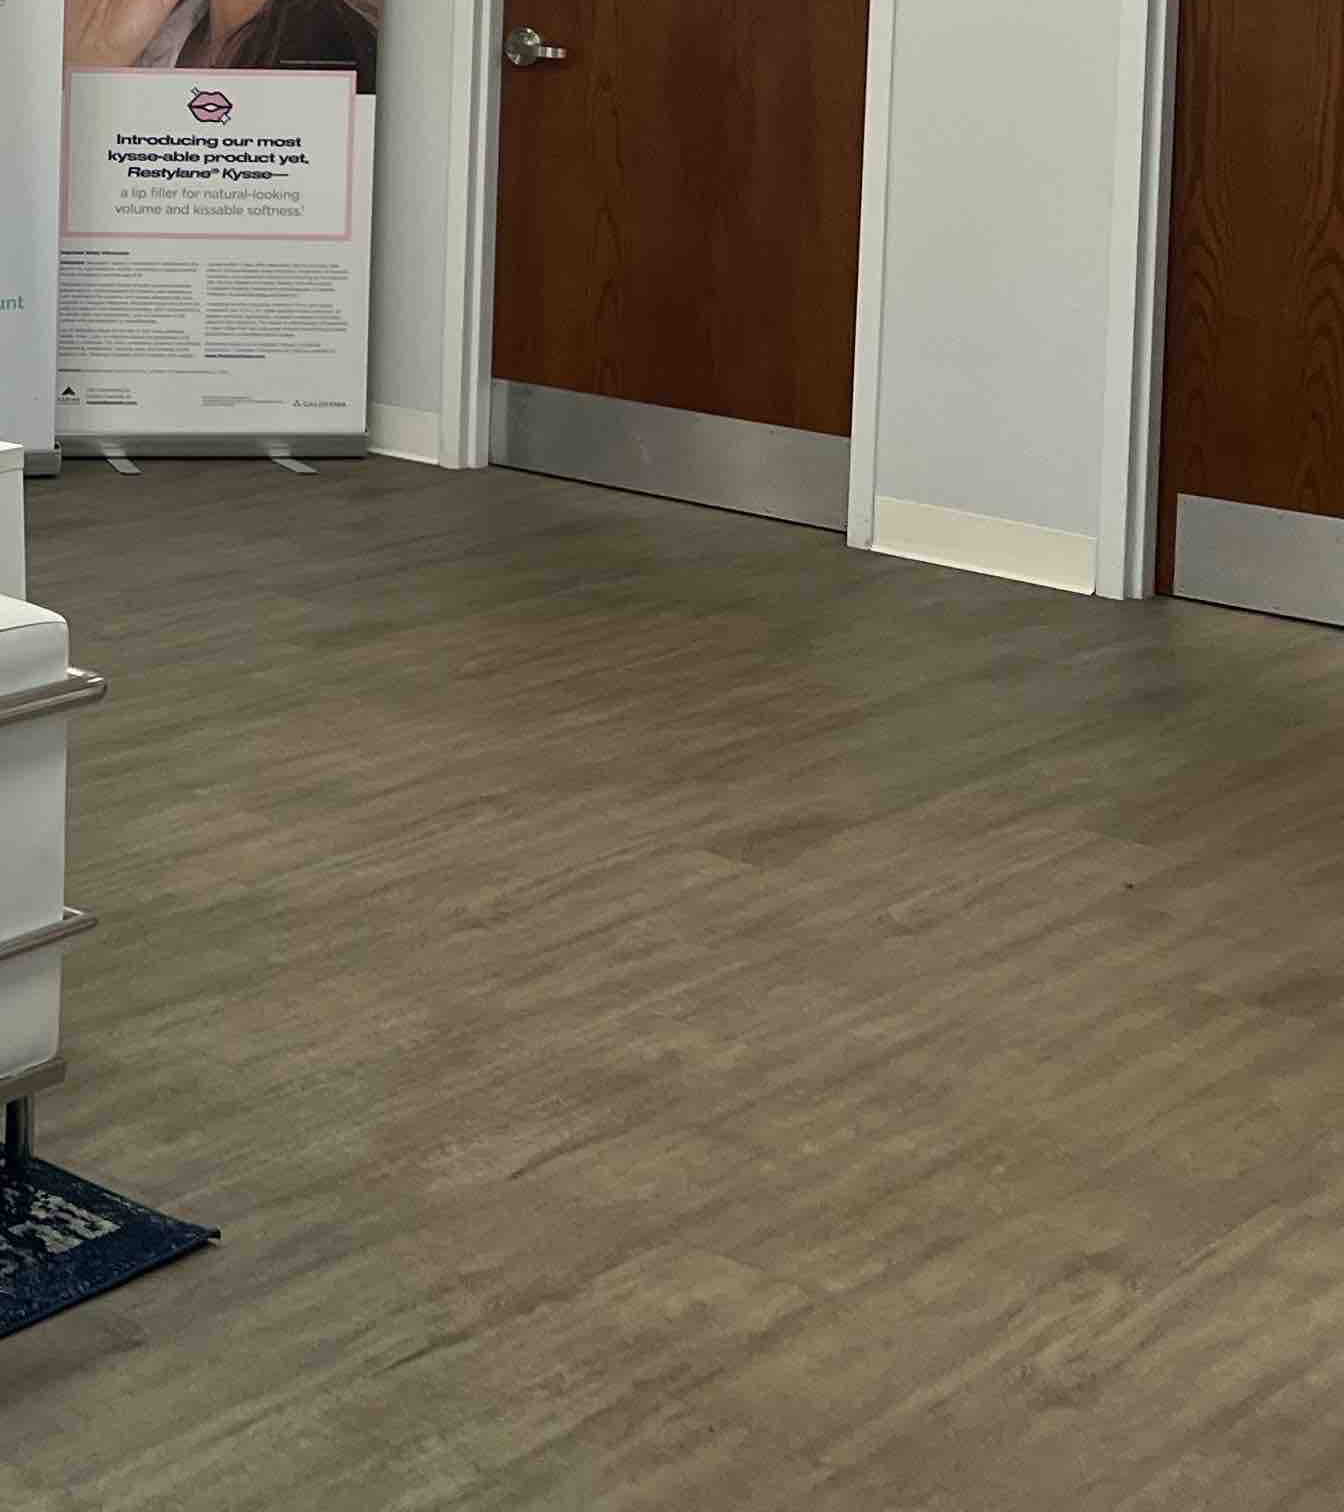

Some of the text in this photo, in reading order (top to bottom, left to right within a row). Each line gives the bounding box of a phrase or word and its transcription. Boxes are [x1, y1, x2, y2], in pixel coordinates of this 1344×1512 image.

[116, 134, 302, 149] Introducing our most
[108, 149, 201, 163] kysse-able
[204, 151, 276, 165] product
[120, 187, 300, 203] a lip filler for natural-looking
[114, 204, 162, 216] volume
[165, 204, 190, 216] and
[193, 204, 244, 217] kissable
